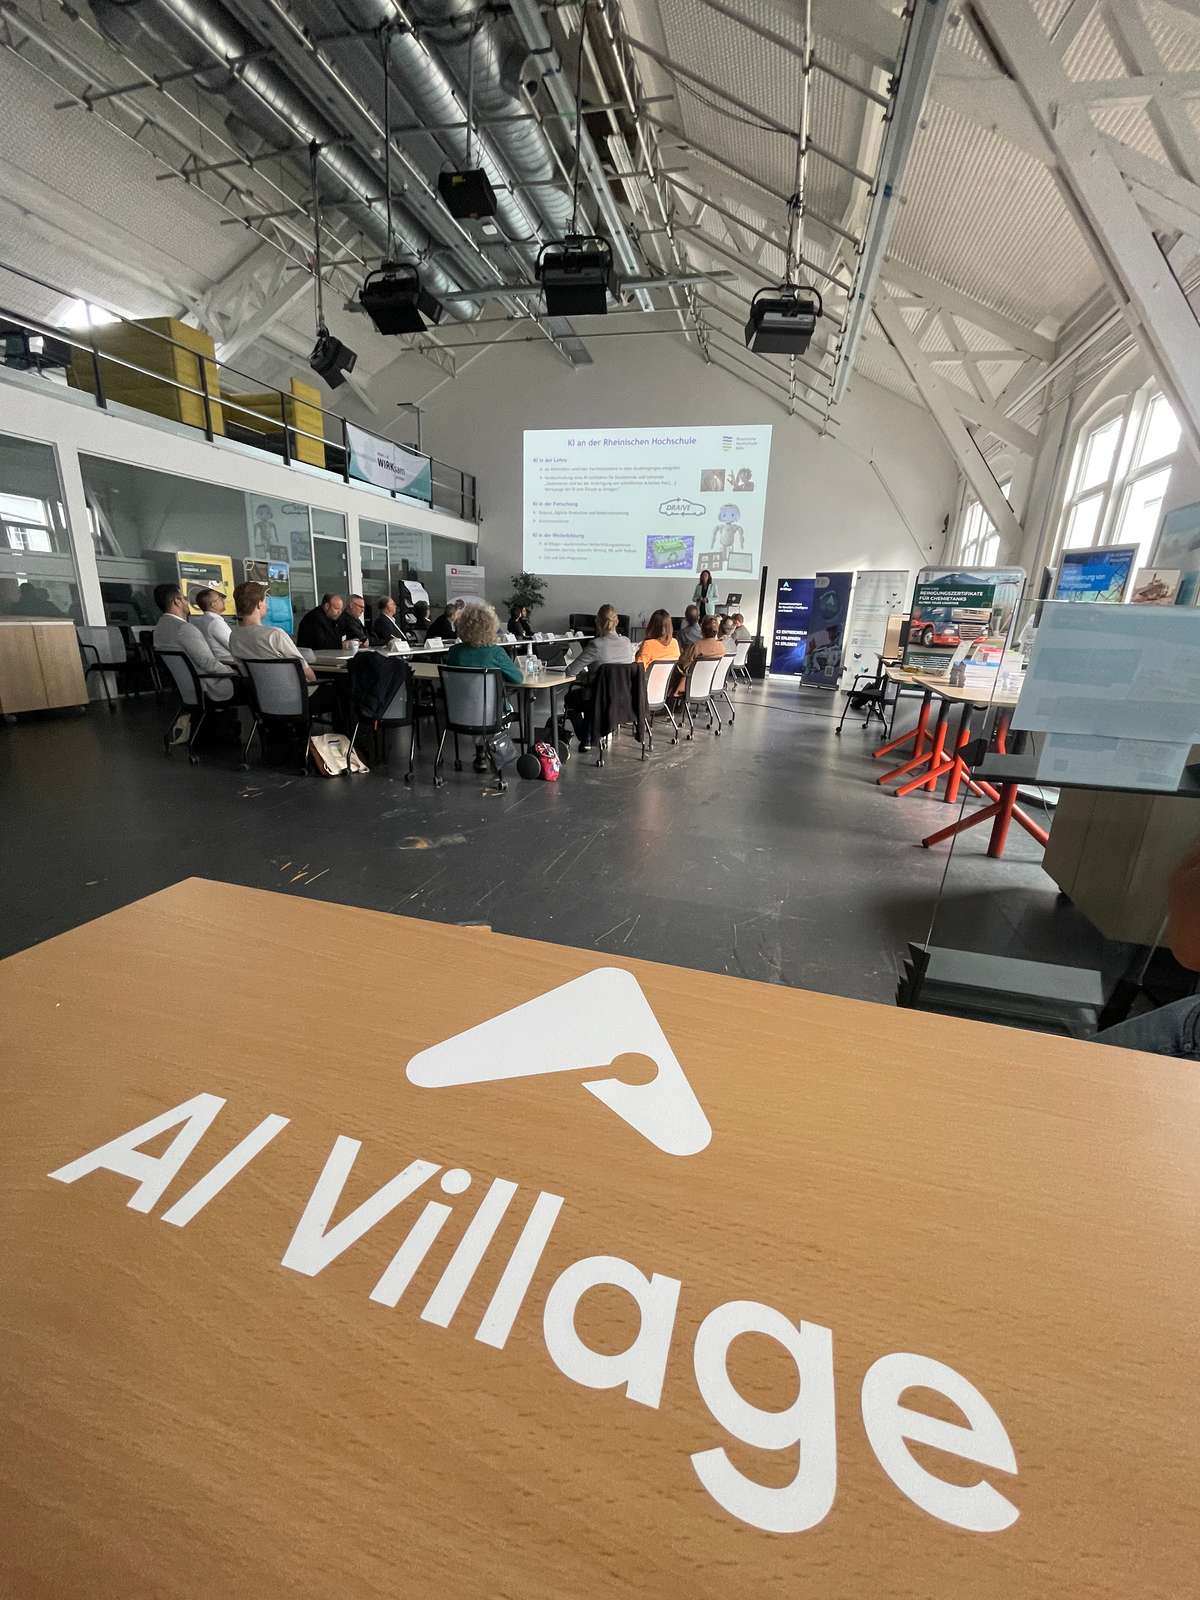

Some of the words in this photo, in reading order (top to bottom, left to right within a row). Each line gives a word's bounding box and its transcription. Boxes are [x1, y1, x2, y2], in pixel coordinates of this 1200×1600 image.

[567, 439, 575, 447] KI
[588, 438, 601, 447] der
[603, 438, 650, 446] Rheinischen
[651, 436, 697, 445] Hochschule
[48, 1092, 291, 1227] AI
[280, 1135, 1021, 1534] Village
